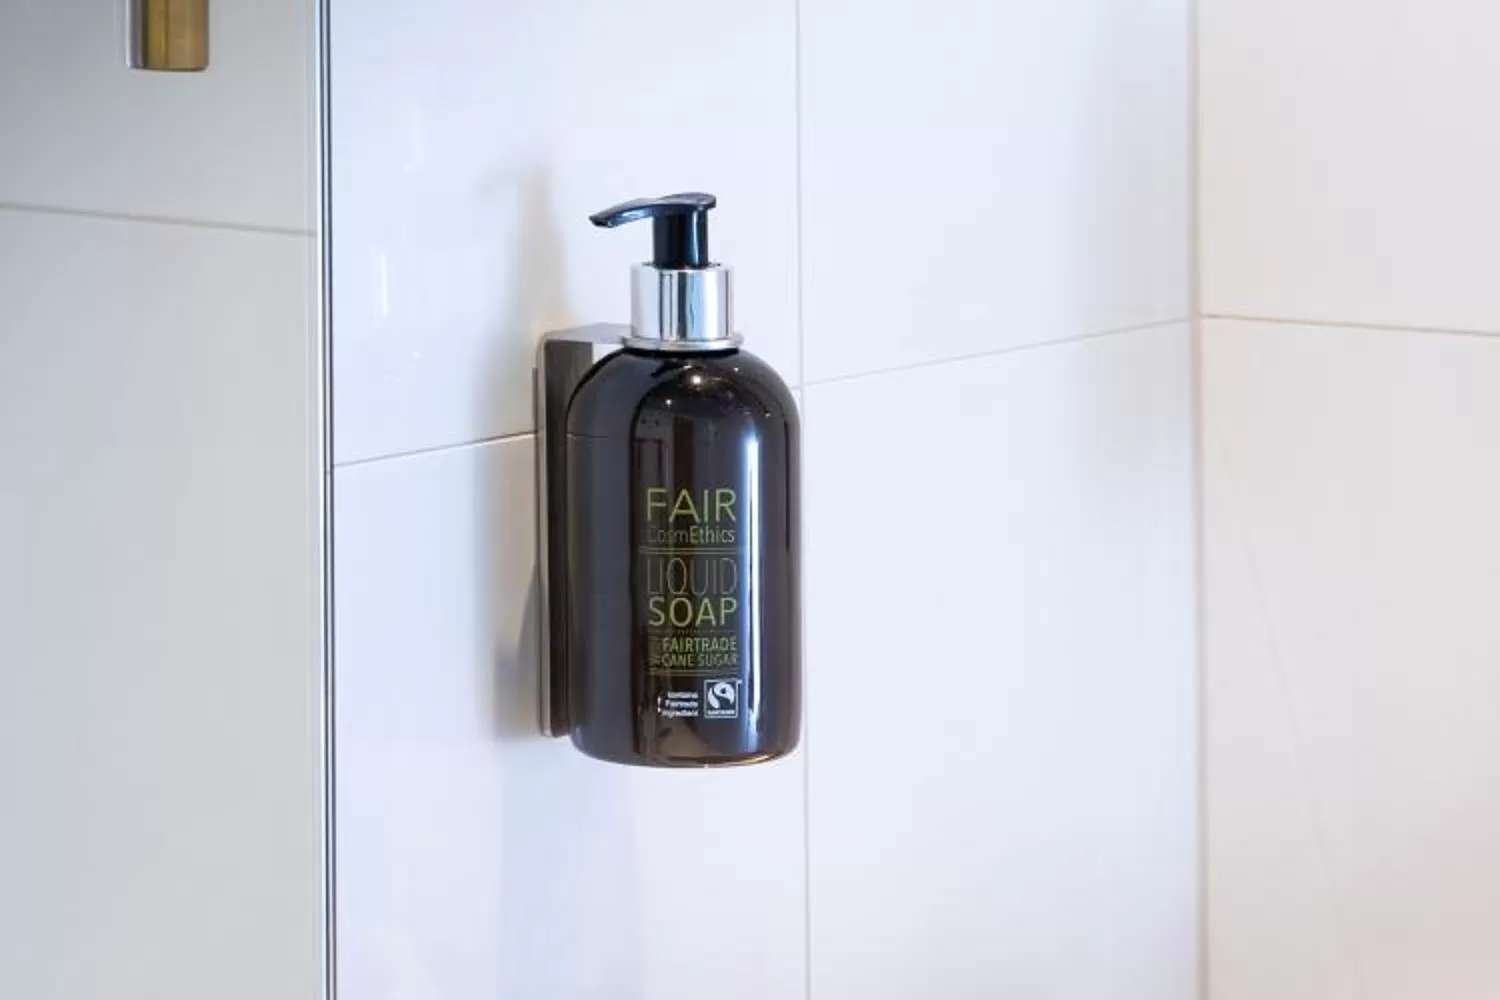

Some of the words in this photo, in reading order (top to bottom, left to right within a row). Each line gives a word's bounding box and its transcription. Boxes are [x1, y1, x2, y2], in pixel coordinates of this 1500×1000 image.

[646, 488, 738, 523] FAIR
[647, 557, 739, 595] LIQUID
[649, 597, 738, 627] SOAP
[661, 636, 738, 653] FAIRTRADE
[661, 653, 695, 668] CANE
